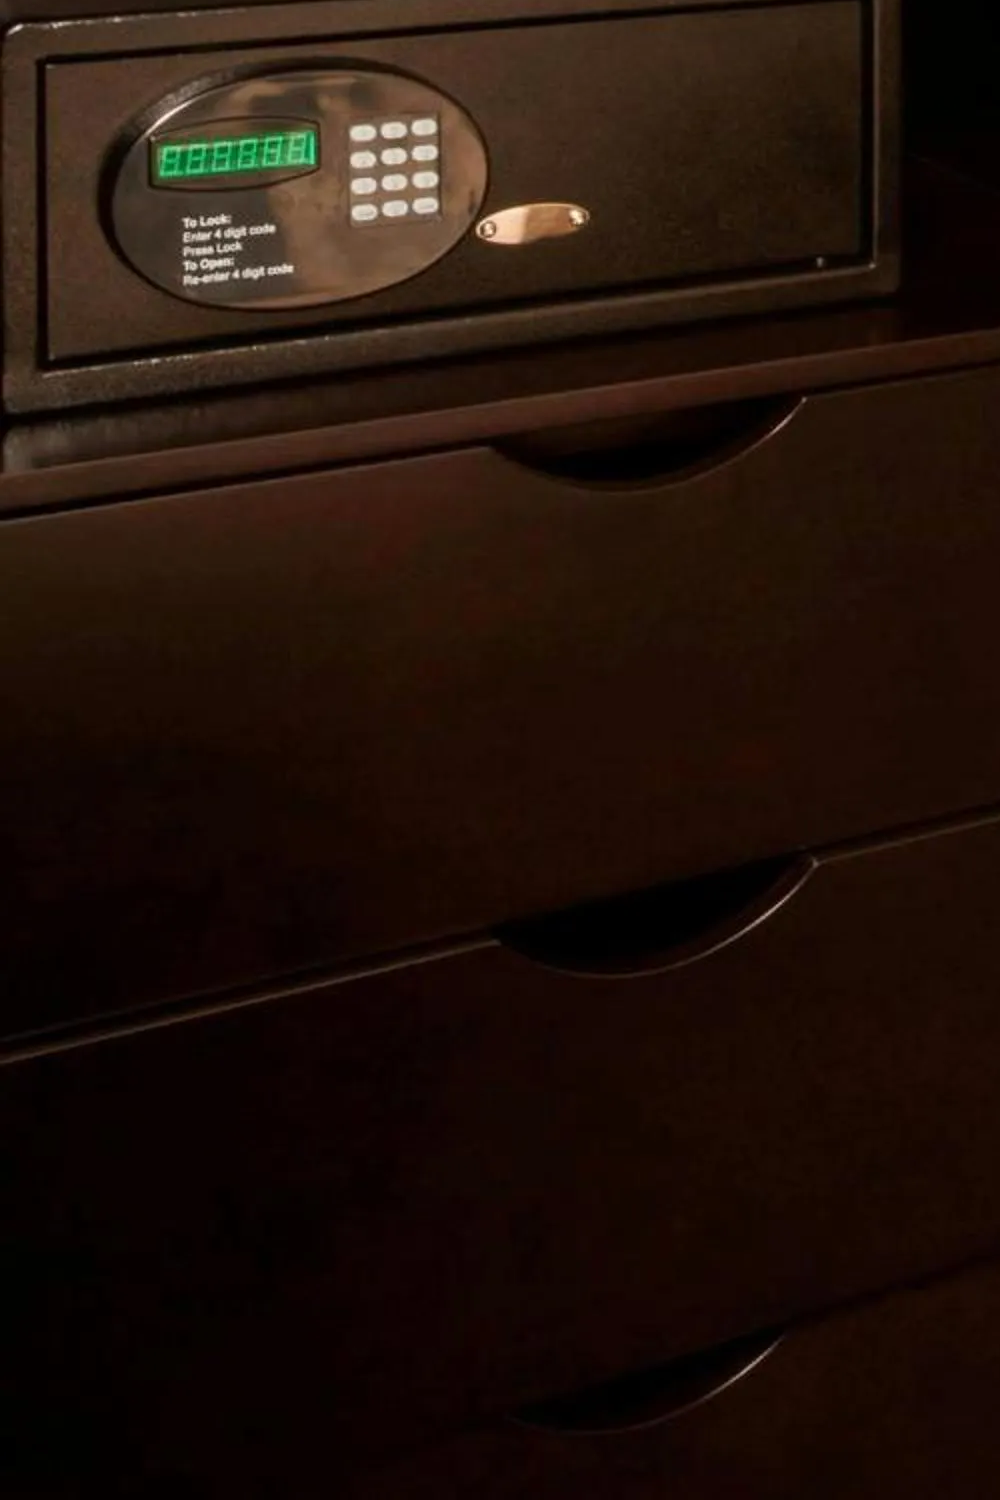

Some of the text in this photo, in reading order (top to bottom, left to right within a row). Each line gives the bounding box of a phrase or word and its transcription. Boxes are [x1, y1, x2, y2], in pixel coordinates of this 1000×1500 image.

[182, 213, 232, 228] To Lock:
[182, 223, 276, 242] Enter 4 digit code
[182, 241, 242, 256] Press Lock
[182, 257, 234, 271] To Open:
[182, 263, 294, 285] Re-enter 4 digit code
